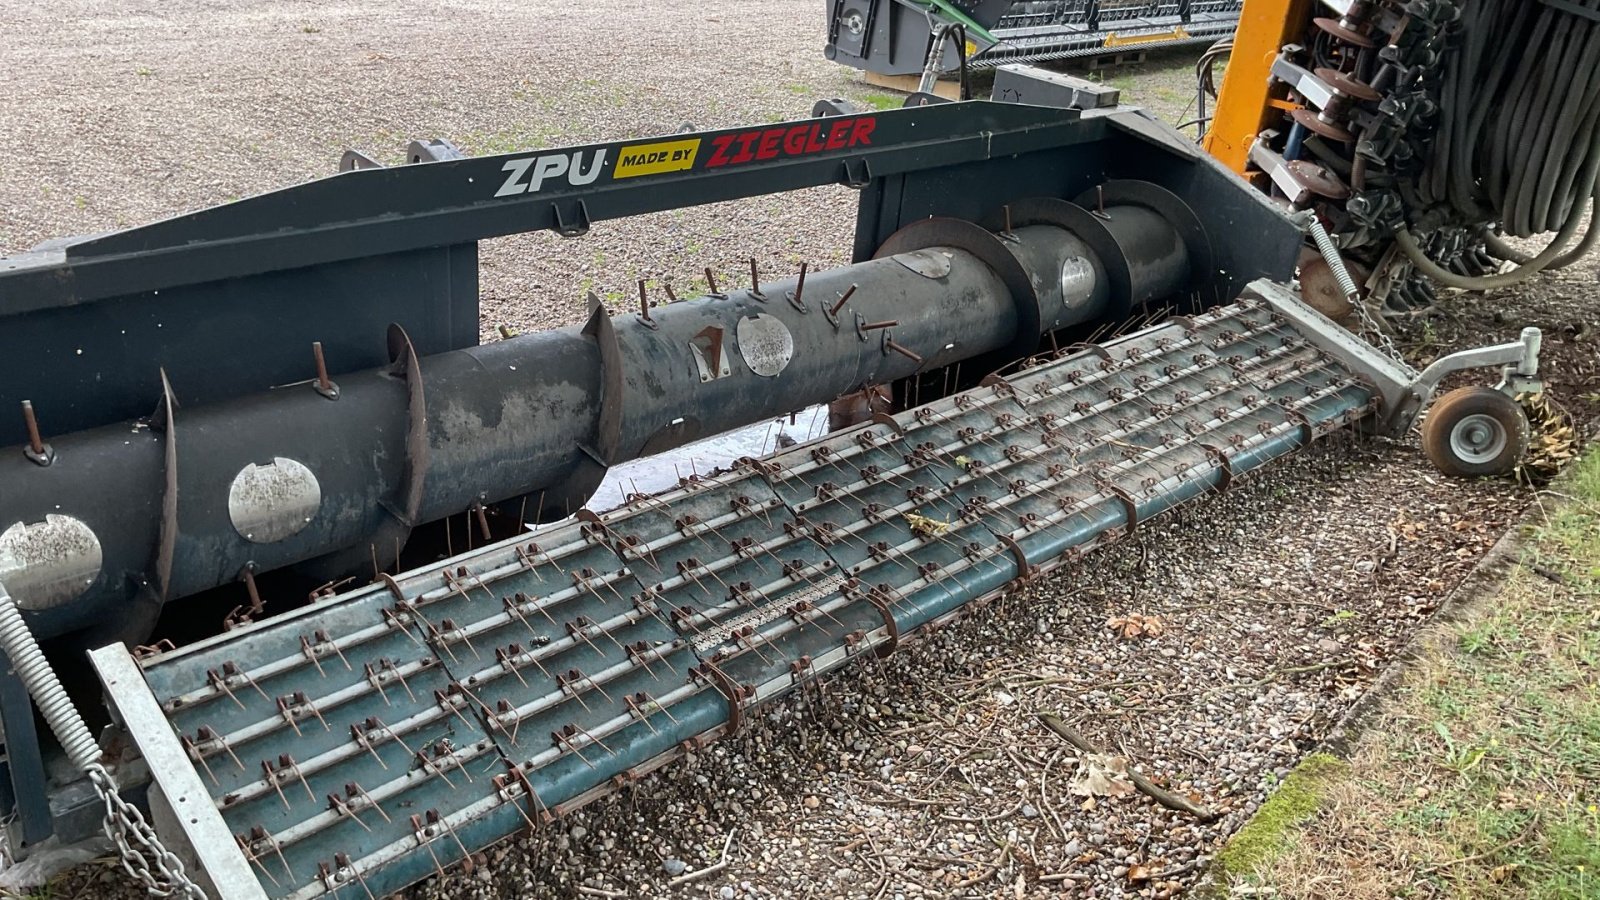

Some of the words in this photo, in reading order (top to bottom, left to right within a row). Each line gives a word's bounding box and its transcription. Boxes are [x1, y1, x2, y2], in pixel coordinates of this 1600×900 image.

[494, 148, 607, 198] ZPU
[622, 151, 667, 168] MADE
[670, 148, 694, 162] BY
[707, 117, 876, 168] ZIEGLER
